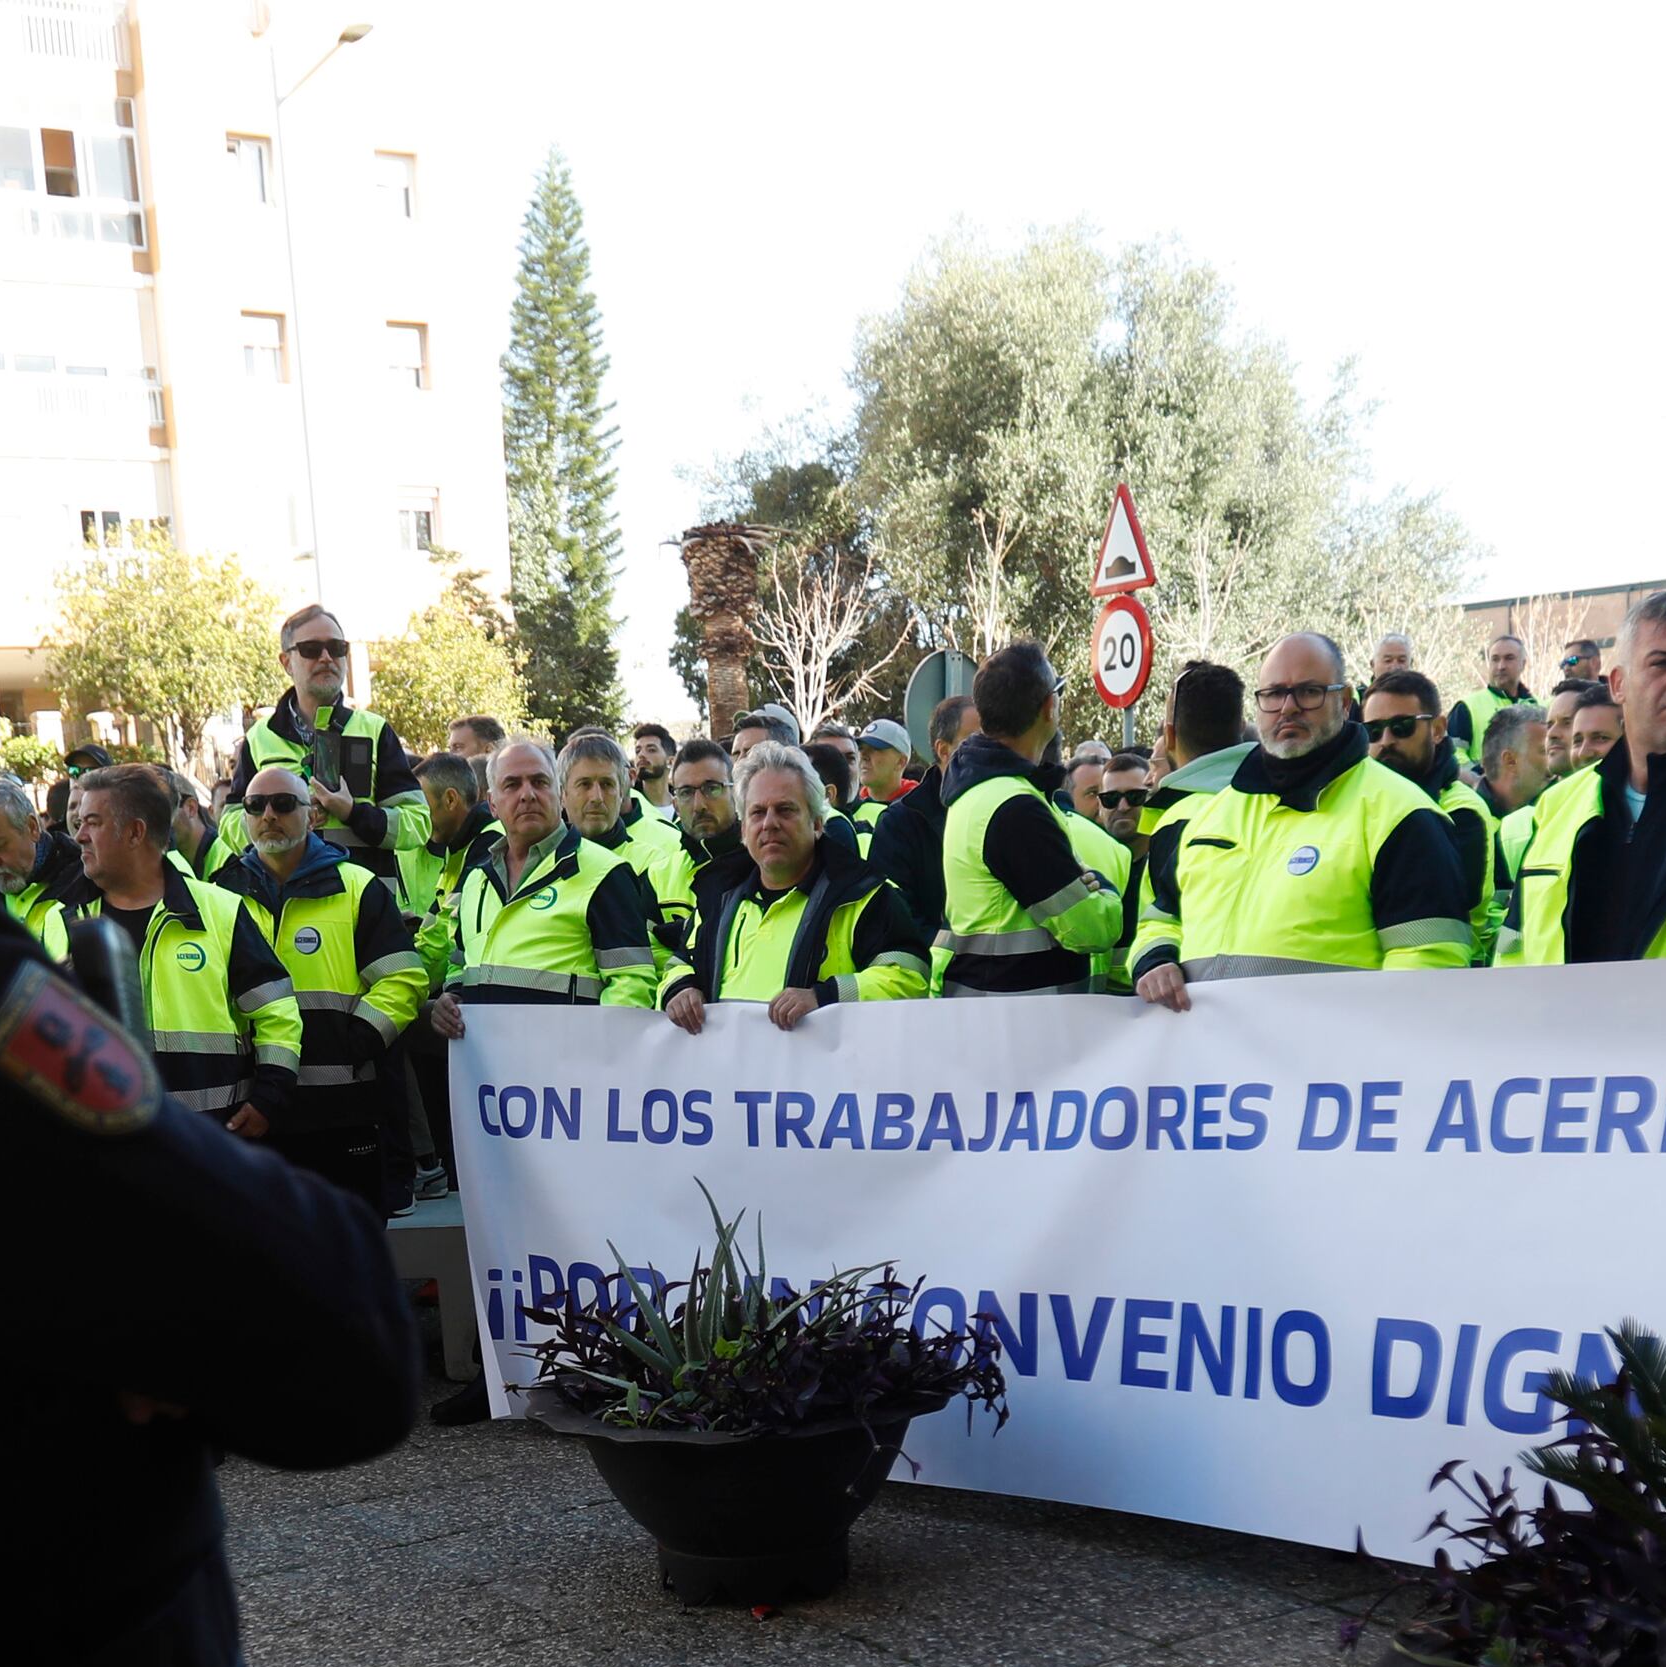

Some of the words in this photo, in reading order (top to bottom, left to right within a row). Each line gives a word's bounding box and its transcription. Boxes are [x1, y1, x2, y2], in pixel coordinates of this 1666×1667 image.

[1102, 632, 1136, 672] 20
[478, 1083, 582, 1142] CON
[606, 1088, 714, 1147] LOS
[734, 1082, 1274, 1153] TRABAJADORES
[1297, 1080, 1404, 1153] DE
